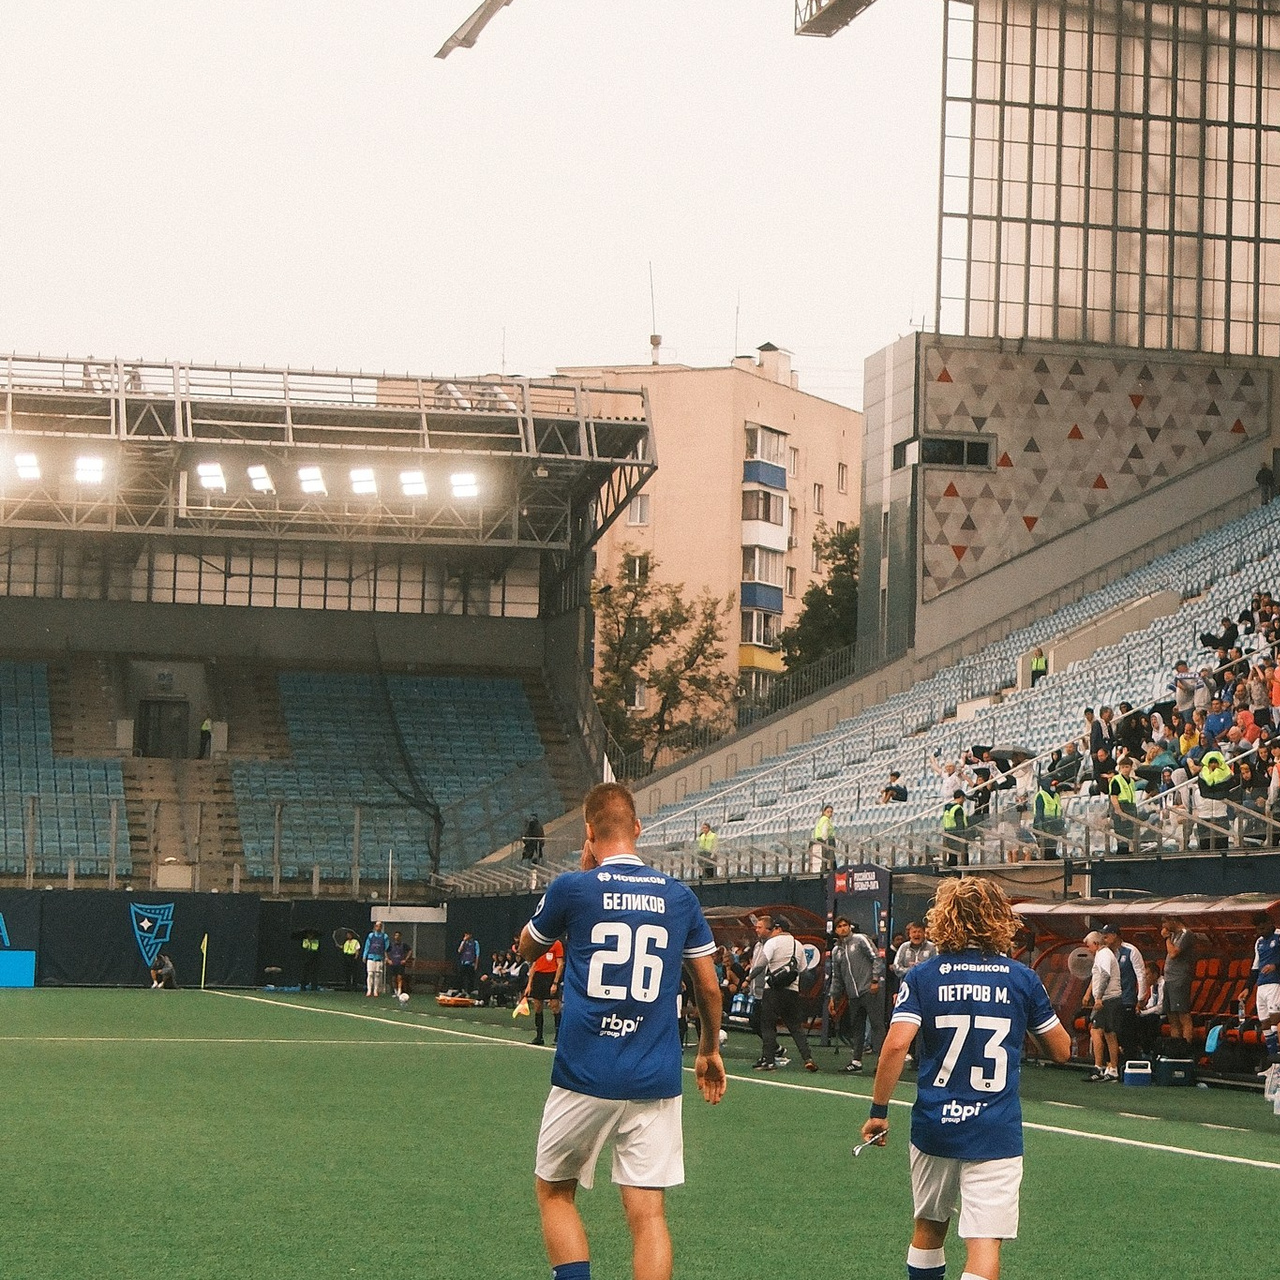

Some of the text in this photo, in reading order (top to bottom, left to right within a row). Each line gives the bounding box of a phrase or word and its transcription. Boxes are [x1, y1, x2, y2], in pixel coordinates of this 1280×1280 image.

[612, 873, 666, 886] НОВИКОМ
[602, 892, 666, 914] БЕЛИКОВ
[587, 921, 669, 1003] 26
[953, 963, 1010, 974] НОВИКОМ
[938, 984, 1011, 1004] ПЕТРОВ М.
[932, 1014, 1012, 1093] 73
